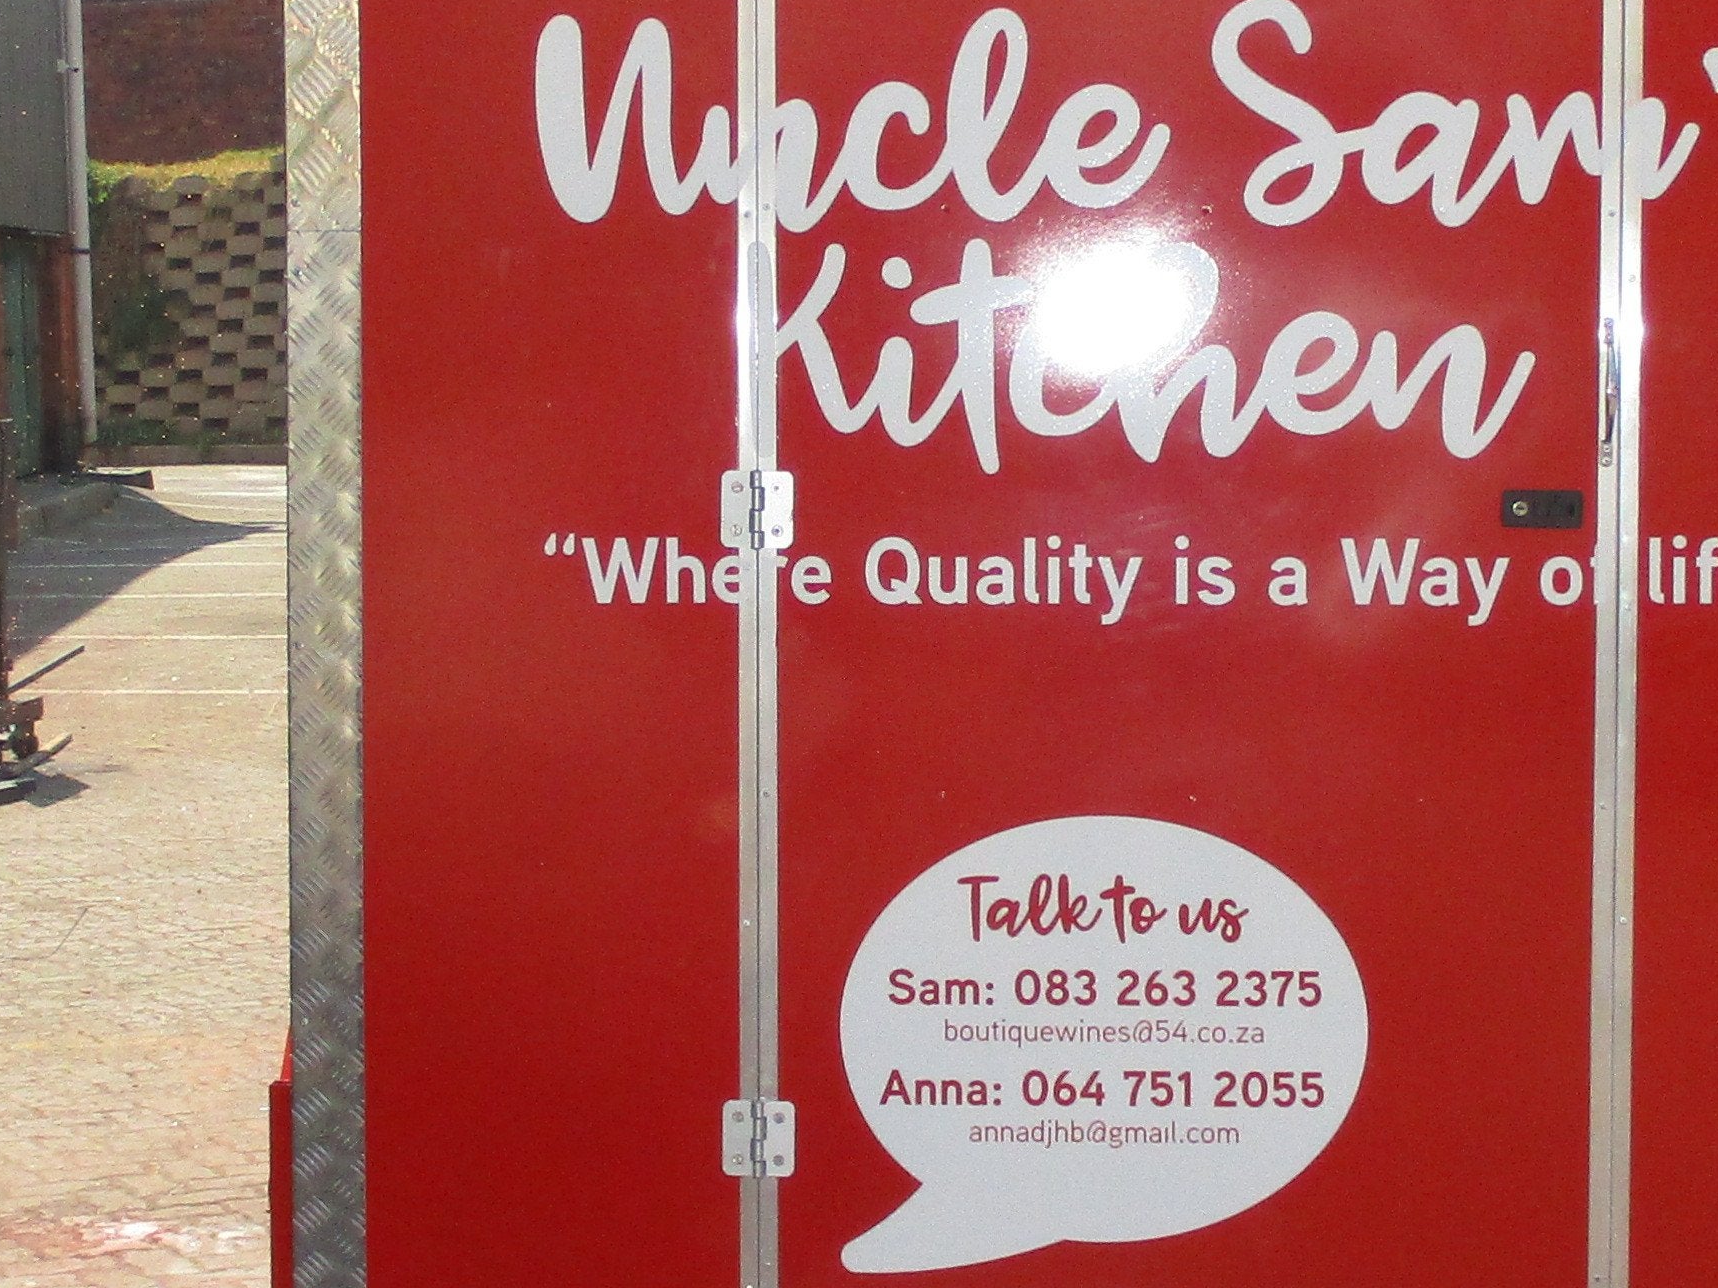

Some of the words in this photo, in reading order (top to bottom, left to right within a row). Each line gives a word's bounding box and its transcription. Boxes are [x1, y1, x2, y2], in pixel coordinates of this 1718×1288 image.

[535, 8, 1172, 233] Uncle
[747, 238, 1538, 475] Kitchen
[865, 536, 1144, 627] Quality
[1175, 536, 1237, 607] is
[1269, 557, 1310, 608] a
[1341, 538, 1511, 628] Way
[958, 873, 1103, 944] Talk
[1101, 874, 1167, 945] to
[1179, 896, 1251, 945] us
[889, 968, 995, 1008] Sam:
[1014, 969, 1099, 1008] 083
[1116, 970, 1197, 1009] 263
[1216, 970, 1324, 1009] 2375
[943, 1019, 1266, 1049] boutiquewines@54.co.za
[880, 1069, 1004, 1108] Anna:
[1022, 1069, 1106, 1109] 064
[1123, 1070, 1194, 1109] 751
[1213, 1070, 1327, 1110] 2055
[968, 1119, 1241, 1149] annadjhb@gmail.com
